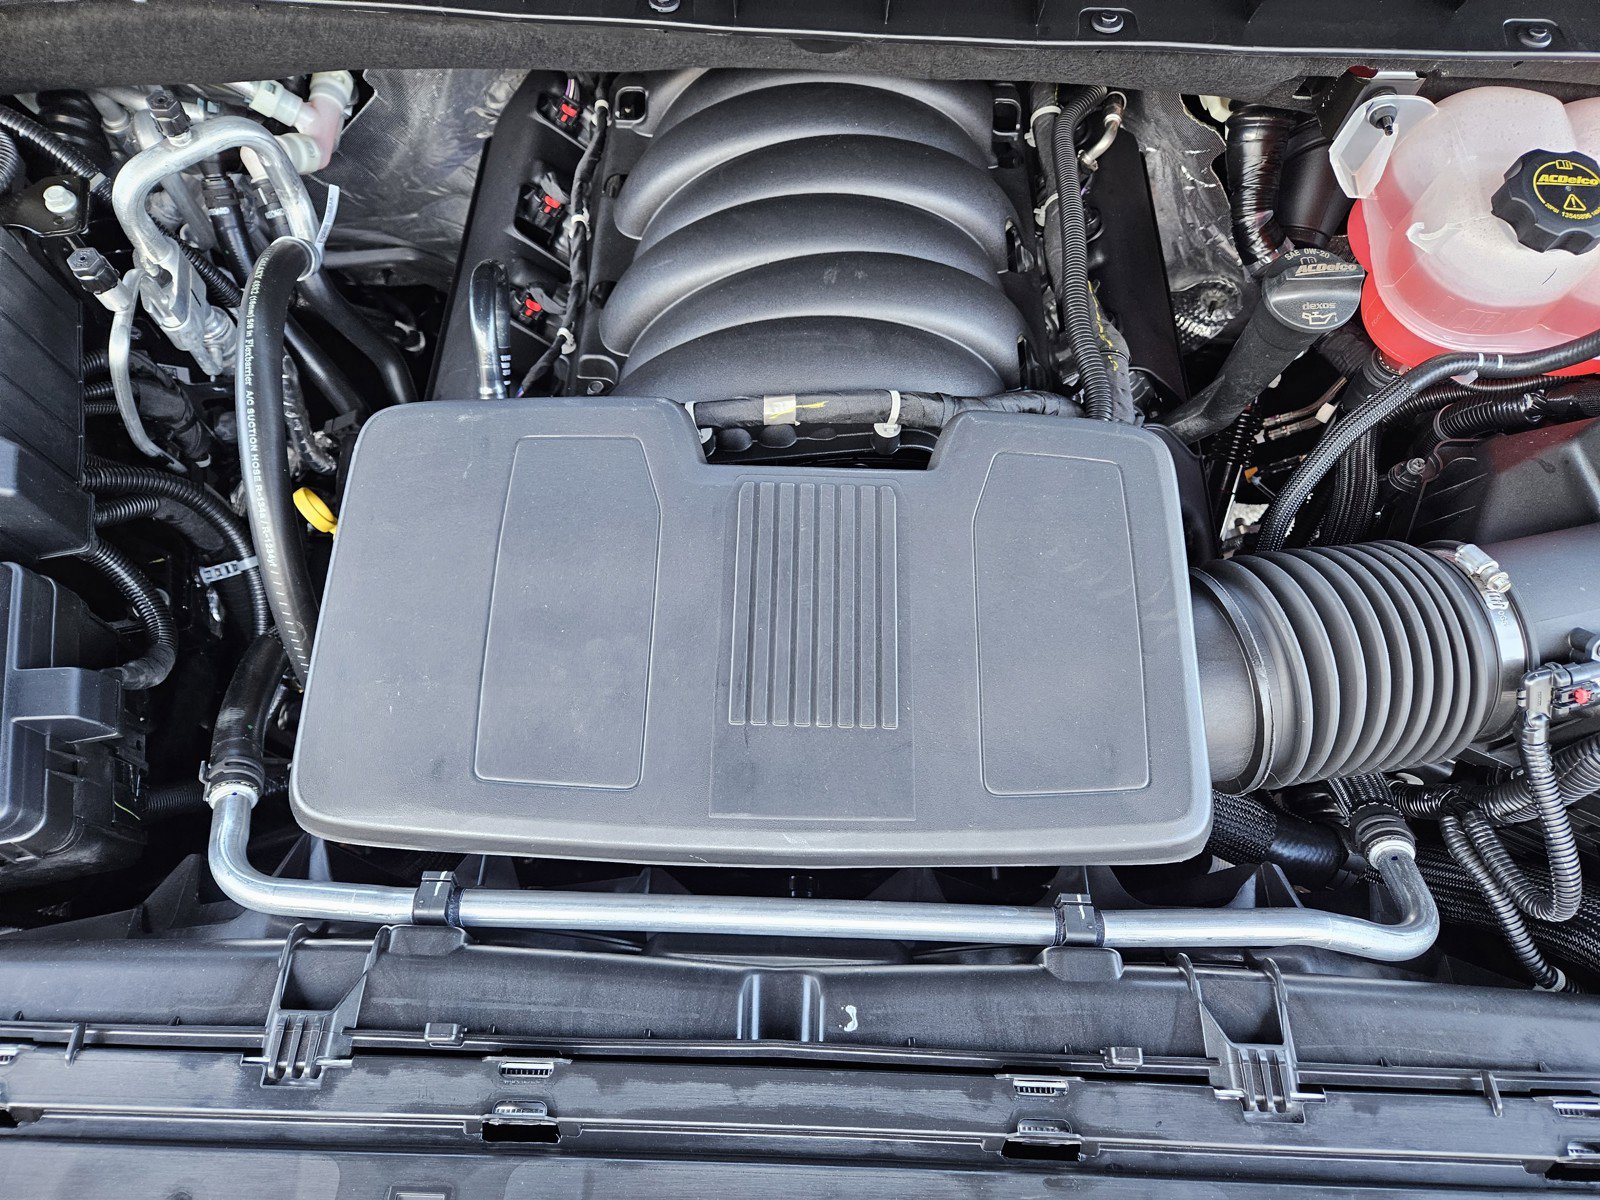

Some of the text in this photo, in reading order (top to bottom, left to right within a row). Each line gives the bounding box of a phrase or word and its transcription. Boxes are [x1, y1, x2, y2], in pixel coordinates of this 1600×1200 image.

[1537, 174, 1599, 186] ACDelco
[1284, 248, 1330, 261] SAE 0W-20
[1294, 262, 1357, 277] ACDelco
[1302, 302, 1337, 311] dexos
[246, 318, 255, 330] 5/8
[245, 390, 255, 406] A/C
[246, 407, 259, 452] SUCTION
[251, 454, 262, 483] HOSE
